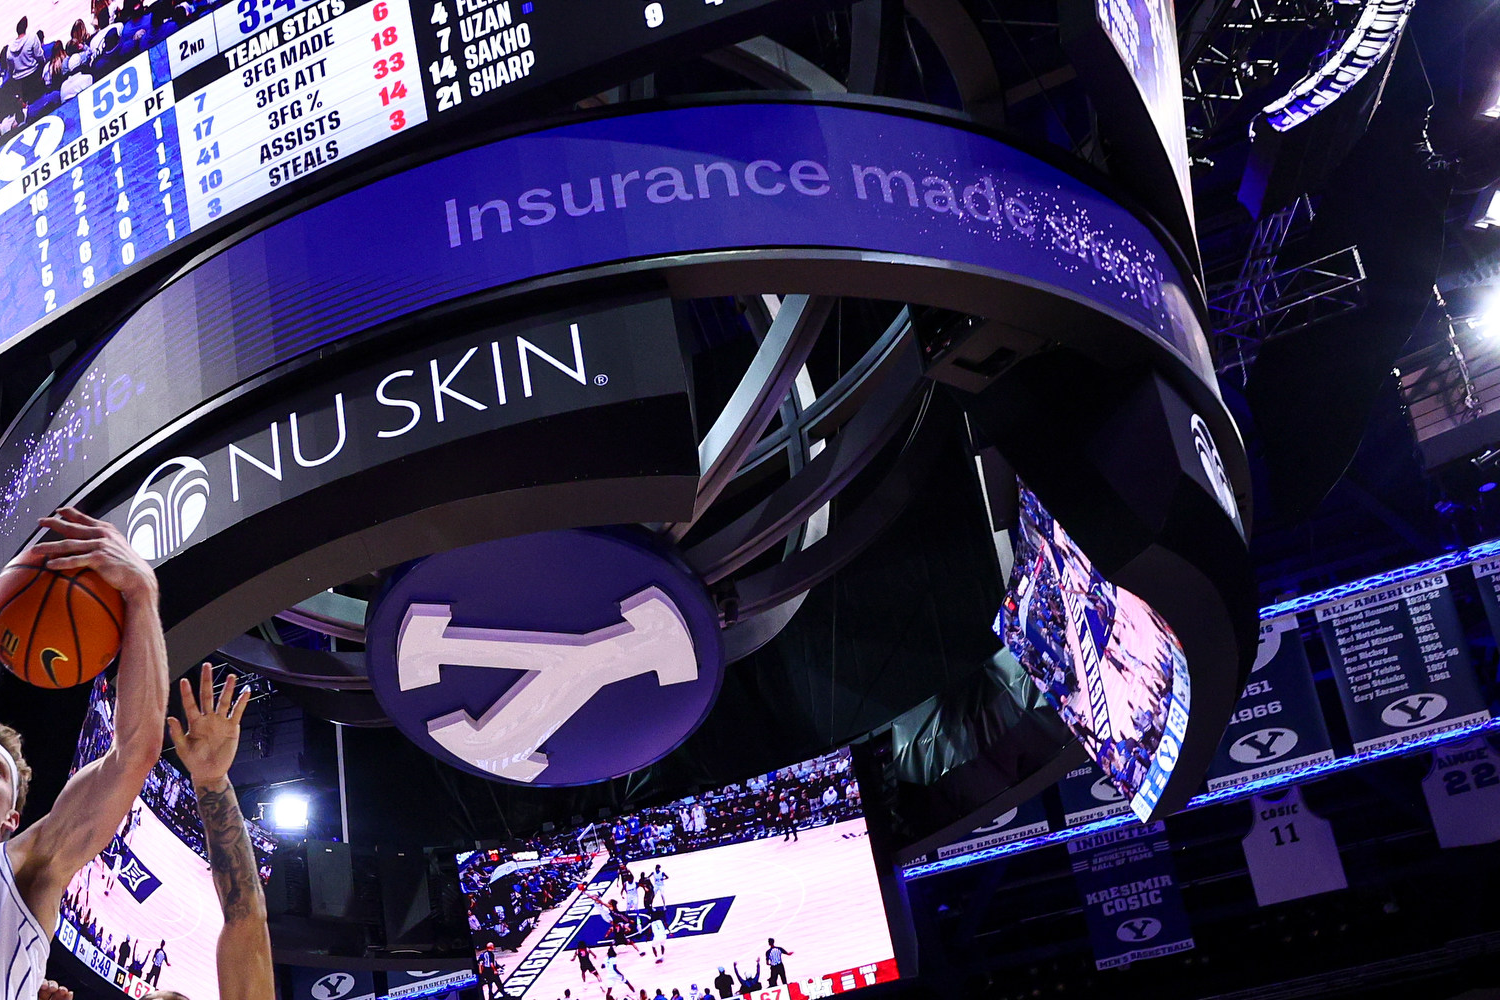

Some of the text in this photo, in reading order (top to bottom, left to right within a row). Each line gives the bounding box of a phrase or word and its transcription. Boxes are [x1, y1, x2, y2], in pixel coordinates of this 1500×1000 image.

[225, 0, 346, 71] TEAM STATS
[430, 1, 449, 26] 4
[436, 26, 451, 54] 7
[459, 1, 512, 43] UZAN
[179, 38, 205, 61] 2ND
[194, 1, 389, 113] 7 3FG MADE 6
[428, 21, 531, 85] 14 SAKHO
[92, 66, 139, 120] 59
[193, 26, 398, 142] 17 3FG ATT 18
[435, 49, 535, 113] 21 SHARP
[196, 51, 405, 166] 41 3FG % 33
[6, 123, 51, 171] Y
[21, 162, 51, 195] PTS
[59, 137, 90, 170] REB
[99, 111, 128, 145] AST
[144, 90, 165, 117] PF
[199, 80, 408, 195] 10 ASSISTS 14
[29, 188, 49, 217] 16
[71, 166, 84, 190] 2
[112, 141, 122, 164] 1
[153, 117, 164, 140] 1
[207, 109, 407, 219] 3 STEALS 3
[36, 216, 48, 238] 0
[74, 190, 87, 215] 2
[115, 167, 124, 189] 1
[156, 142, 166, 165] 1
[39, 239, 49, 263] 7
[77, 216, 90, 237] 4
[116, 191, 130, 213] 4
[158, 167, 173, 192] 2
[445, 157, 1036, 248] Insurance made
[42, 263, 54, 288] 5
[79, 241, 92, 264] 6
[119, 216, 132, 240] 0
[162, 193, 173, 215] 1
[44, 289, 57, 314] 2
[82, 265, 95, 289] 3
[122, 241, 135, 265] 0
[165, 218, 176, 241] 1
[230, 324, 587, 502] NU SKIN
[1322, 576, 1444, 617] ALL-AMERICANS
[399, 585, 698, 782] Y
[1229, 700, 1283, 725] 1966
[1391, 696, 1434, 722] Y
[1239, 731, 1285, 760] Y
[1210, 753, 1333, 791] MEN'S BASKETBALL
[1442, 762, 1500, 797] 22
[1068, 810, 1105, 825] MEN'S
[1076, 822, 1158, 850] INDUCTEE
[1260, 803, 1298, 822] COSIC
[1269, 823, 1300, 846] 11
[940, 825, 1048, 858] MEN'S BASKETBALL
[1086, 875, 1172, 905] KRESIMIR
[1102, 890, 1162, 916] COSIC
[62, 924, 111, 977] 59 3:49
[1123, 920, 1152, 939] Y
[1099, 941, 1192, 970] MEN'S BASKETBALL
[319, 975, 347, 997] Y
[390, 973, 471, 997] MEN'S BASKETBALL
